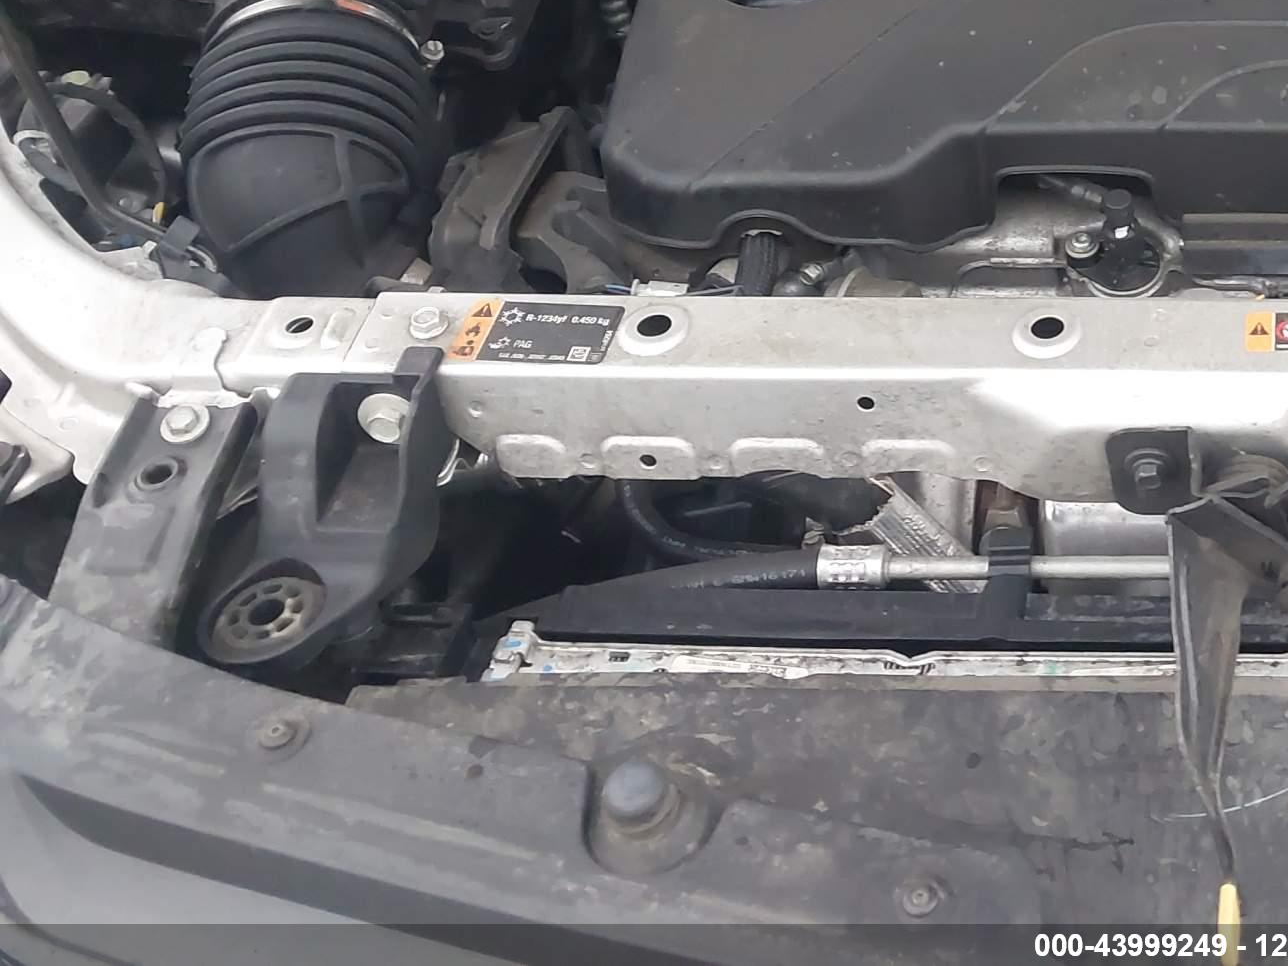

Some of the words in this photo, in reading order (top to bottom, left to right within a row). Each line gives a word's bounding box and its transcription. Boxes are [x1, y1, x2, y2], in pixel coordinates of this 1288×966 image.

[525, 314, 568, 325] R-1234yf
[570, 315, 597, 325] 0.450
[597, 317, 610, 327] kg
[513, 339, 533, 349] PAG
